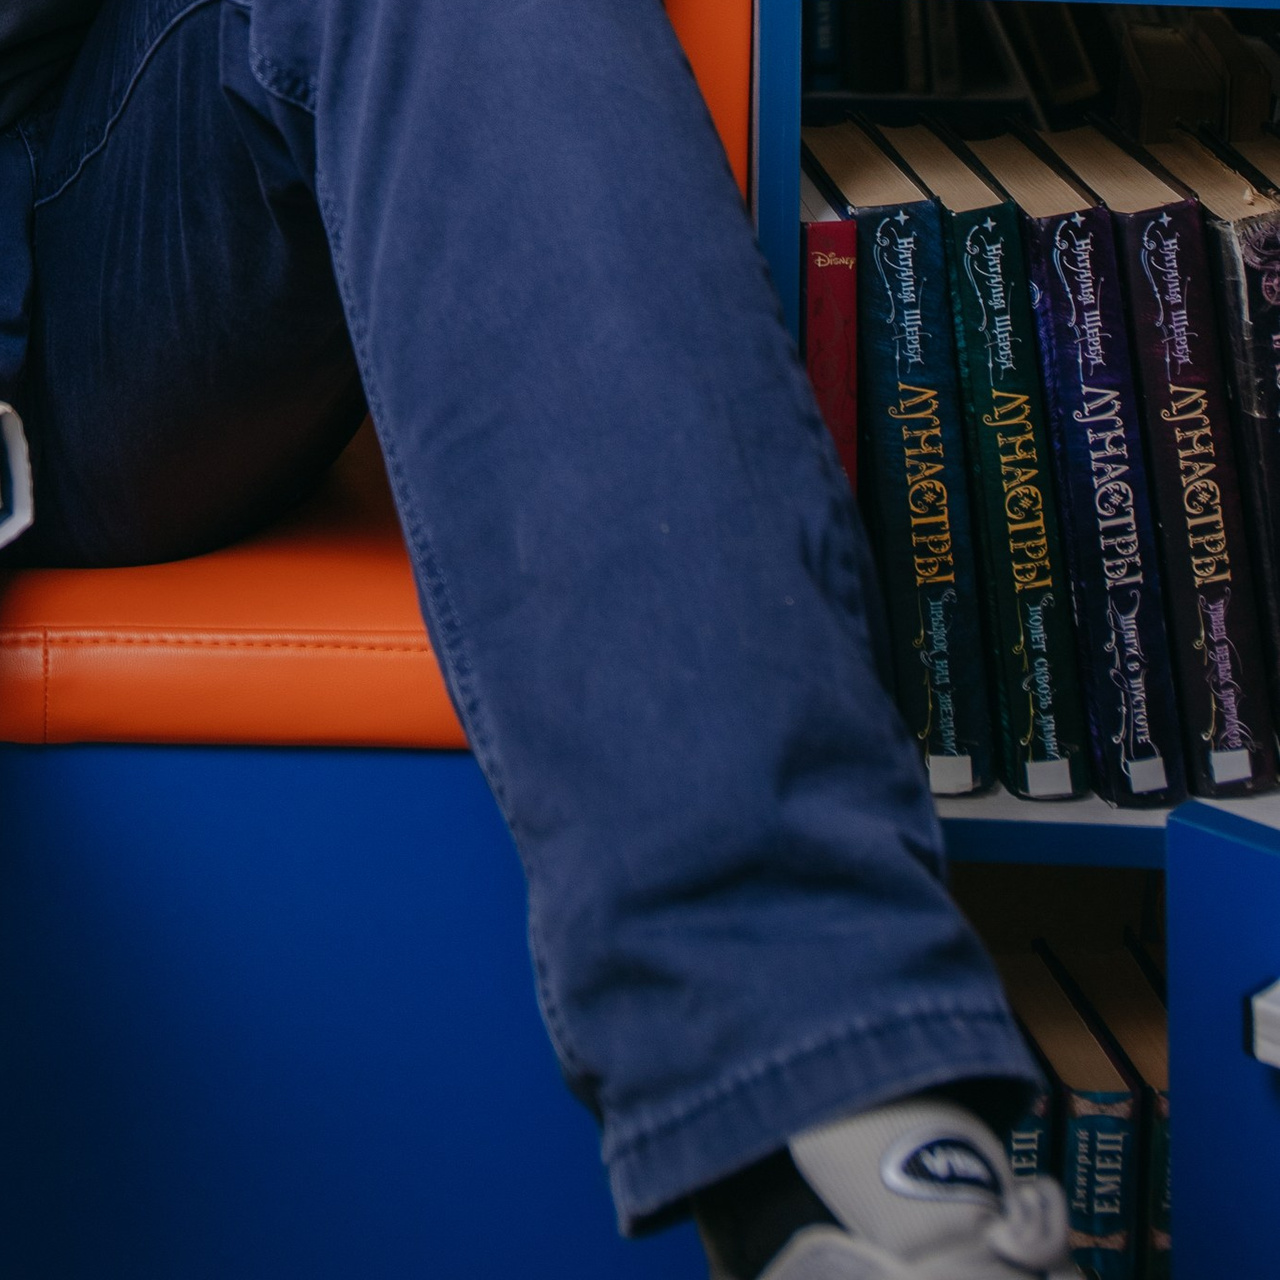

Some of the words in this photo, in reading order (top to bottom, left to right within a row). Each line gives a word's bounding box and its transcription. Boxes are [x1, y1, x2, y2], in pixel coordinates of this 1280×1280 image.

[812, 251, 856, 270] Disney
[888, 381, 956, 587] ЛУНАСТРЫ
[982, 388, 1053, 594] ЛУНАСТРЫ
[1072, 383, 1144, 590] ЛУНАСТРЫ
[1160, 383, 1232, 588] ЛУНАСТРЫ
[1011, 1129, 1045, 1176] ЕЦ
[1072, 1128, 1093, 1216] Дмитрий
[1093, 1130, 1130, 1214] ЕМЕЦ
